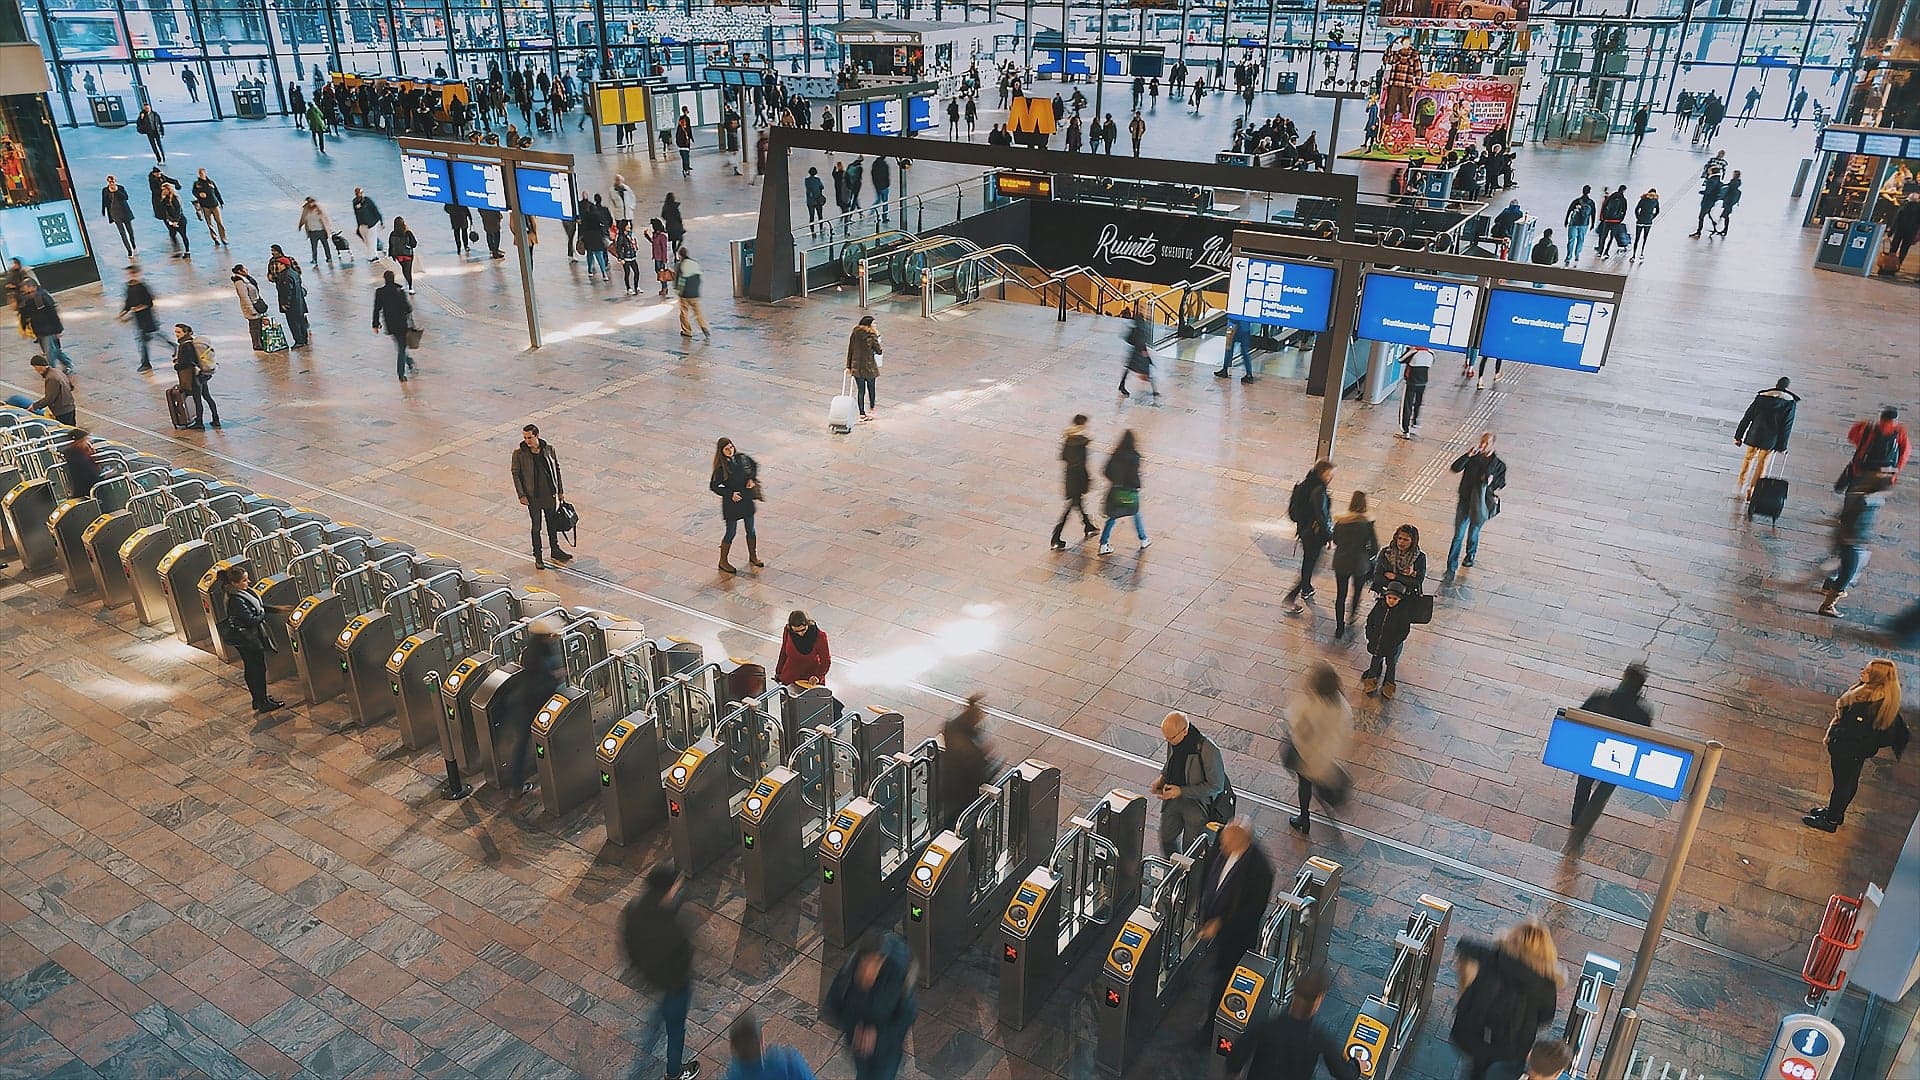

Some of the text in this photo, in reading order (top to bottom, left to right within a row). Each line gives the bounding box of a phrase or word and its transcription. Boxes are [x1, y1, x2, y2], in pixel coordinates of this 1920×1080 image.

[1006, 96, 1057, 134] M
[1092, 223, 1159, 265] Ruimte
[1282, 284, 1308, 295] Service
[1414, 282, 1438, 292] Metro
